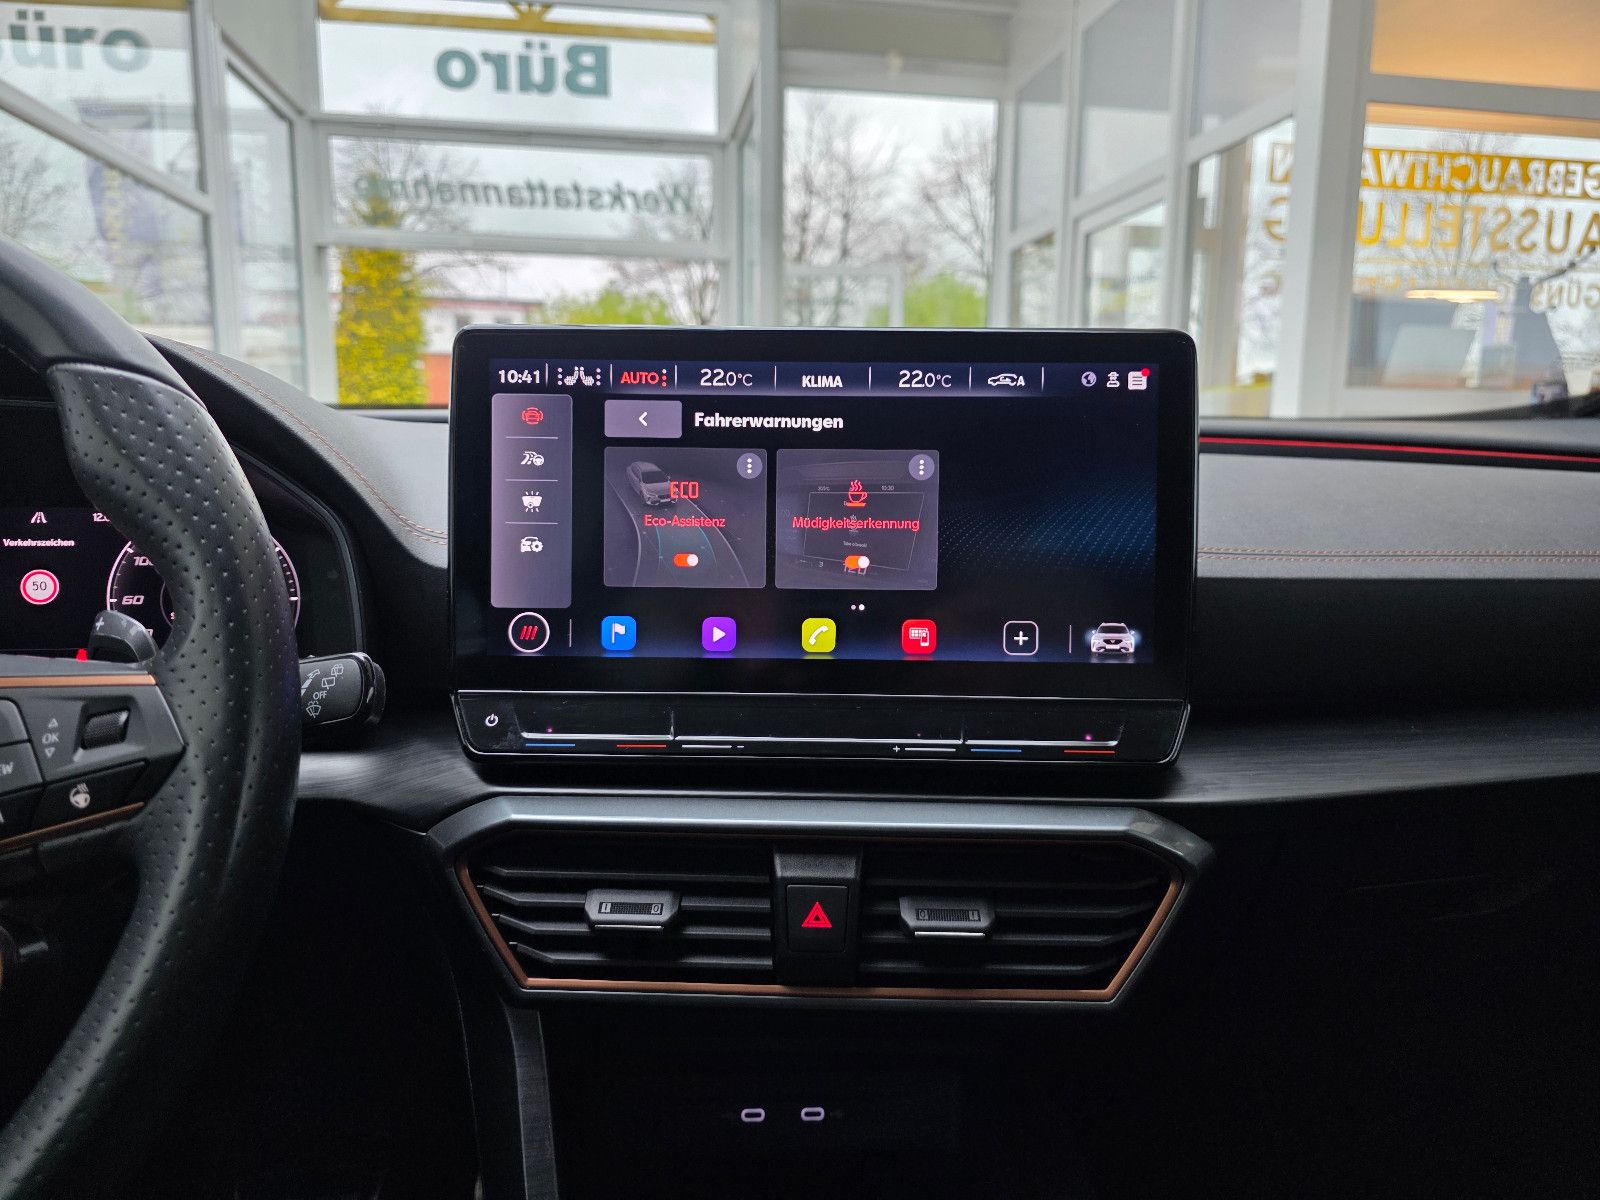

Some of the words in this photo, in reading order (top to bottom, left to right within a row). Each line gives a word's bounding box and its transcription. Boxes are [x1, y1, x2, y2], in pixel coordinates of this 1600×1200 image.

[498, 369, 540, 384] 10:41
[620, 371, 660, 384] AUTO
[802, 375, 843, 388] KLIMA
[694, 412, 844, 432] Fahrerwarnungen
[669, 481, 700, 499] ECO
[643, 514, 726, 527] Eco-Assistenz
[792, 516, 920, 532] Müdigkeitserkennung
[3, 538, 75, 547] Verkehrszeichen
[32, 581, 47, 591] 50
[121, 595, 145, 605] 60
[312, 690, 328, 700] OFF
[42, 732, 60, 744] OK
